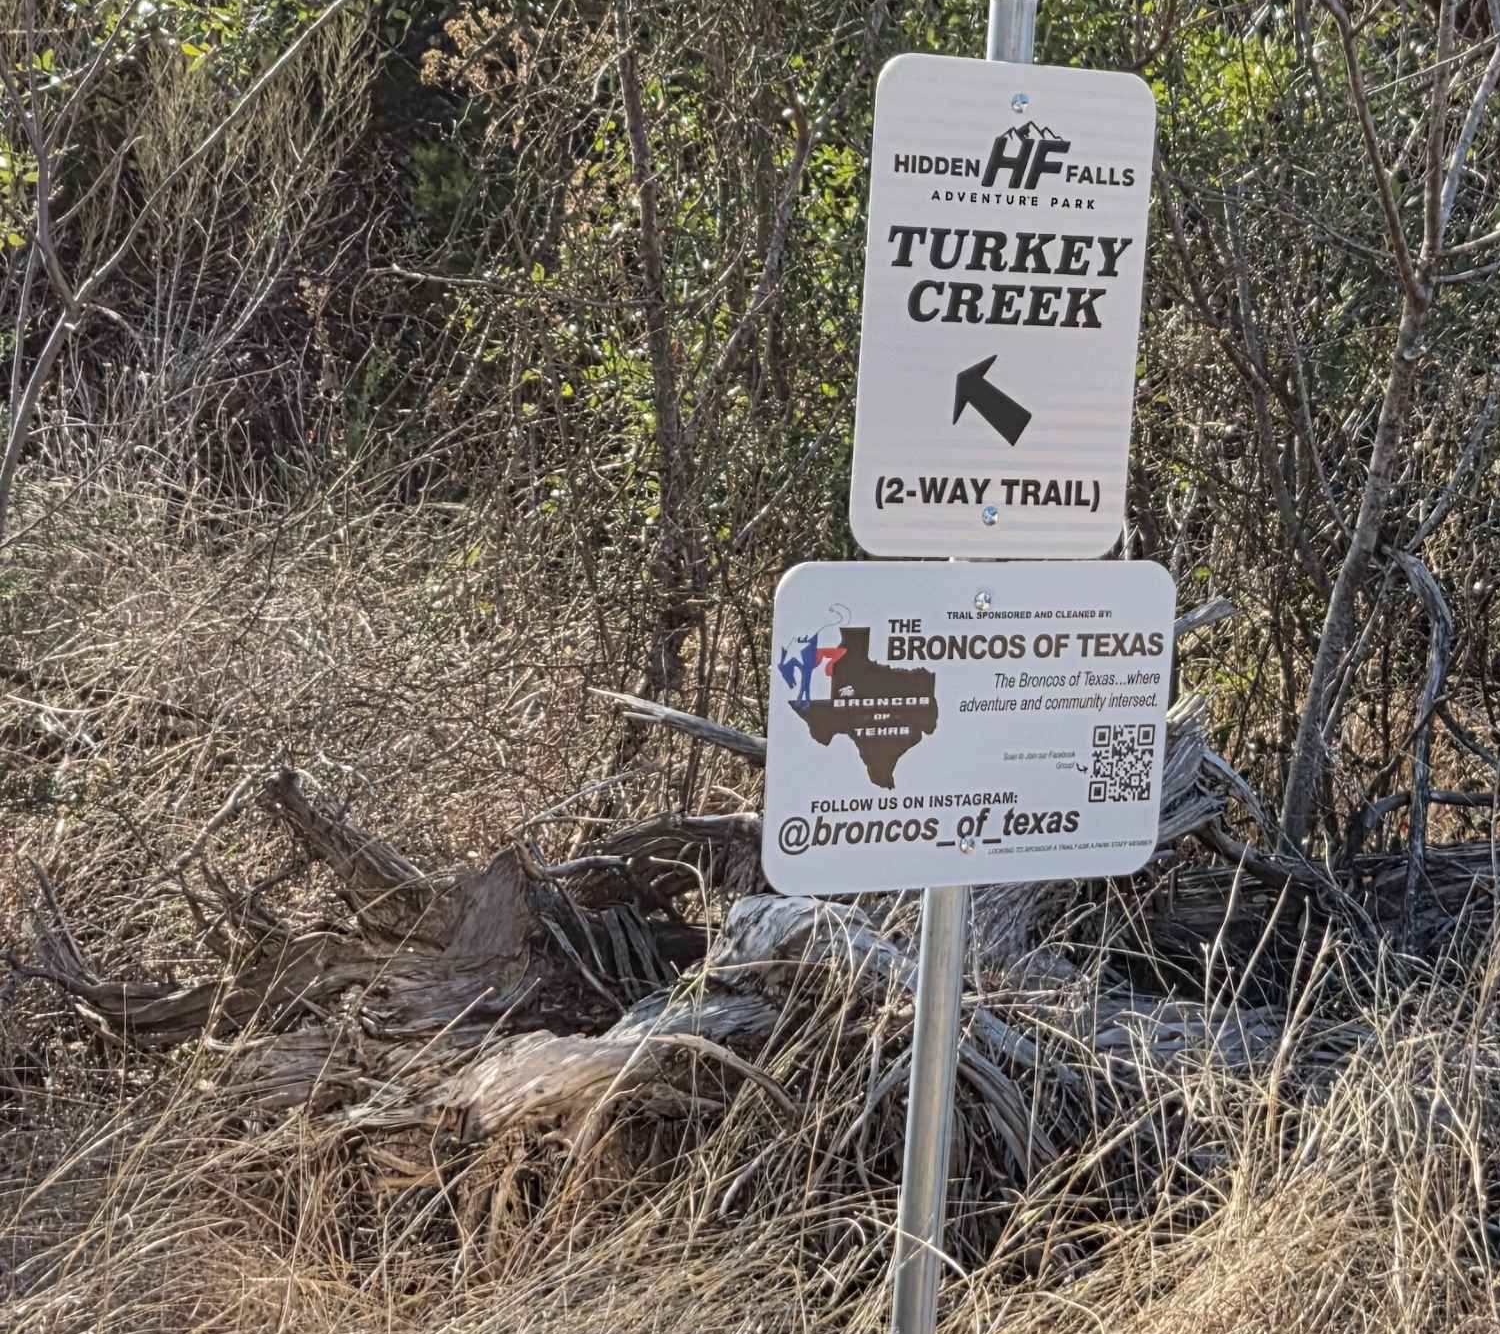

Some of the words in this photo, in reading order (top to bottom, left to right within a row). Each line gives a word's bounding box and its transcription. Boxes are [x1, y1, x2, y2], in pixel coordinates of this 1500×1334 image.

[894, 154, 980, 178] HIDDEN
[1065, 165, 1135, 187] FALLS
[931, 190, 1039, 207] ADVENTURE
[1050, 197, 1096, 210] PARK
[888, 225, 1133, 278] TURKEY
[907, 279, 1107, 329] CREEK
[875, 476, 992, 510] (2-WAY
[1000, 479, 1101, 513] TRAIL)
[946, 611, 974, 620] TRAIL
[976, 611, 1033, 620] SPONSORED
[1034, 610, 1053, 619] AND
[1055, 609, 1096, 619] CLEANED
[888, 619, 922, 634] THE
[887, 634, 1026, 661] BRONCOS
[1033, 634, 1070, 658] OF
[1076, 632, 1164, 657] TEXAS
[994, 673, 1016, 689] The
[1018, 672, 1066, 688] Broncos
[1068, 671, 1082, 687] of
[833, 697, 930, 708] BRONCOS
[959, 697, 1018, 713] adventure
[1019, 695, 1042, 711] and
[1044, 694, 1106, 713] community
[1107, 692, 1159, 709] intersect.
[811, 798, 873, 813] FOLLOW
[877, 797, 898, 810] US
[903, 796, 925, 809] ON
[929, 792, 1018, 808] INSTAGRAM:
[778, 807, 1080, 856] @broncos_of_texas
